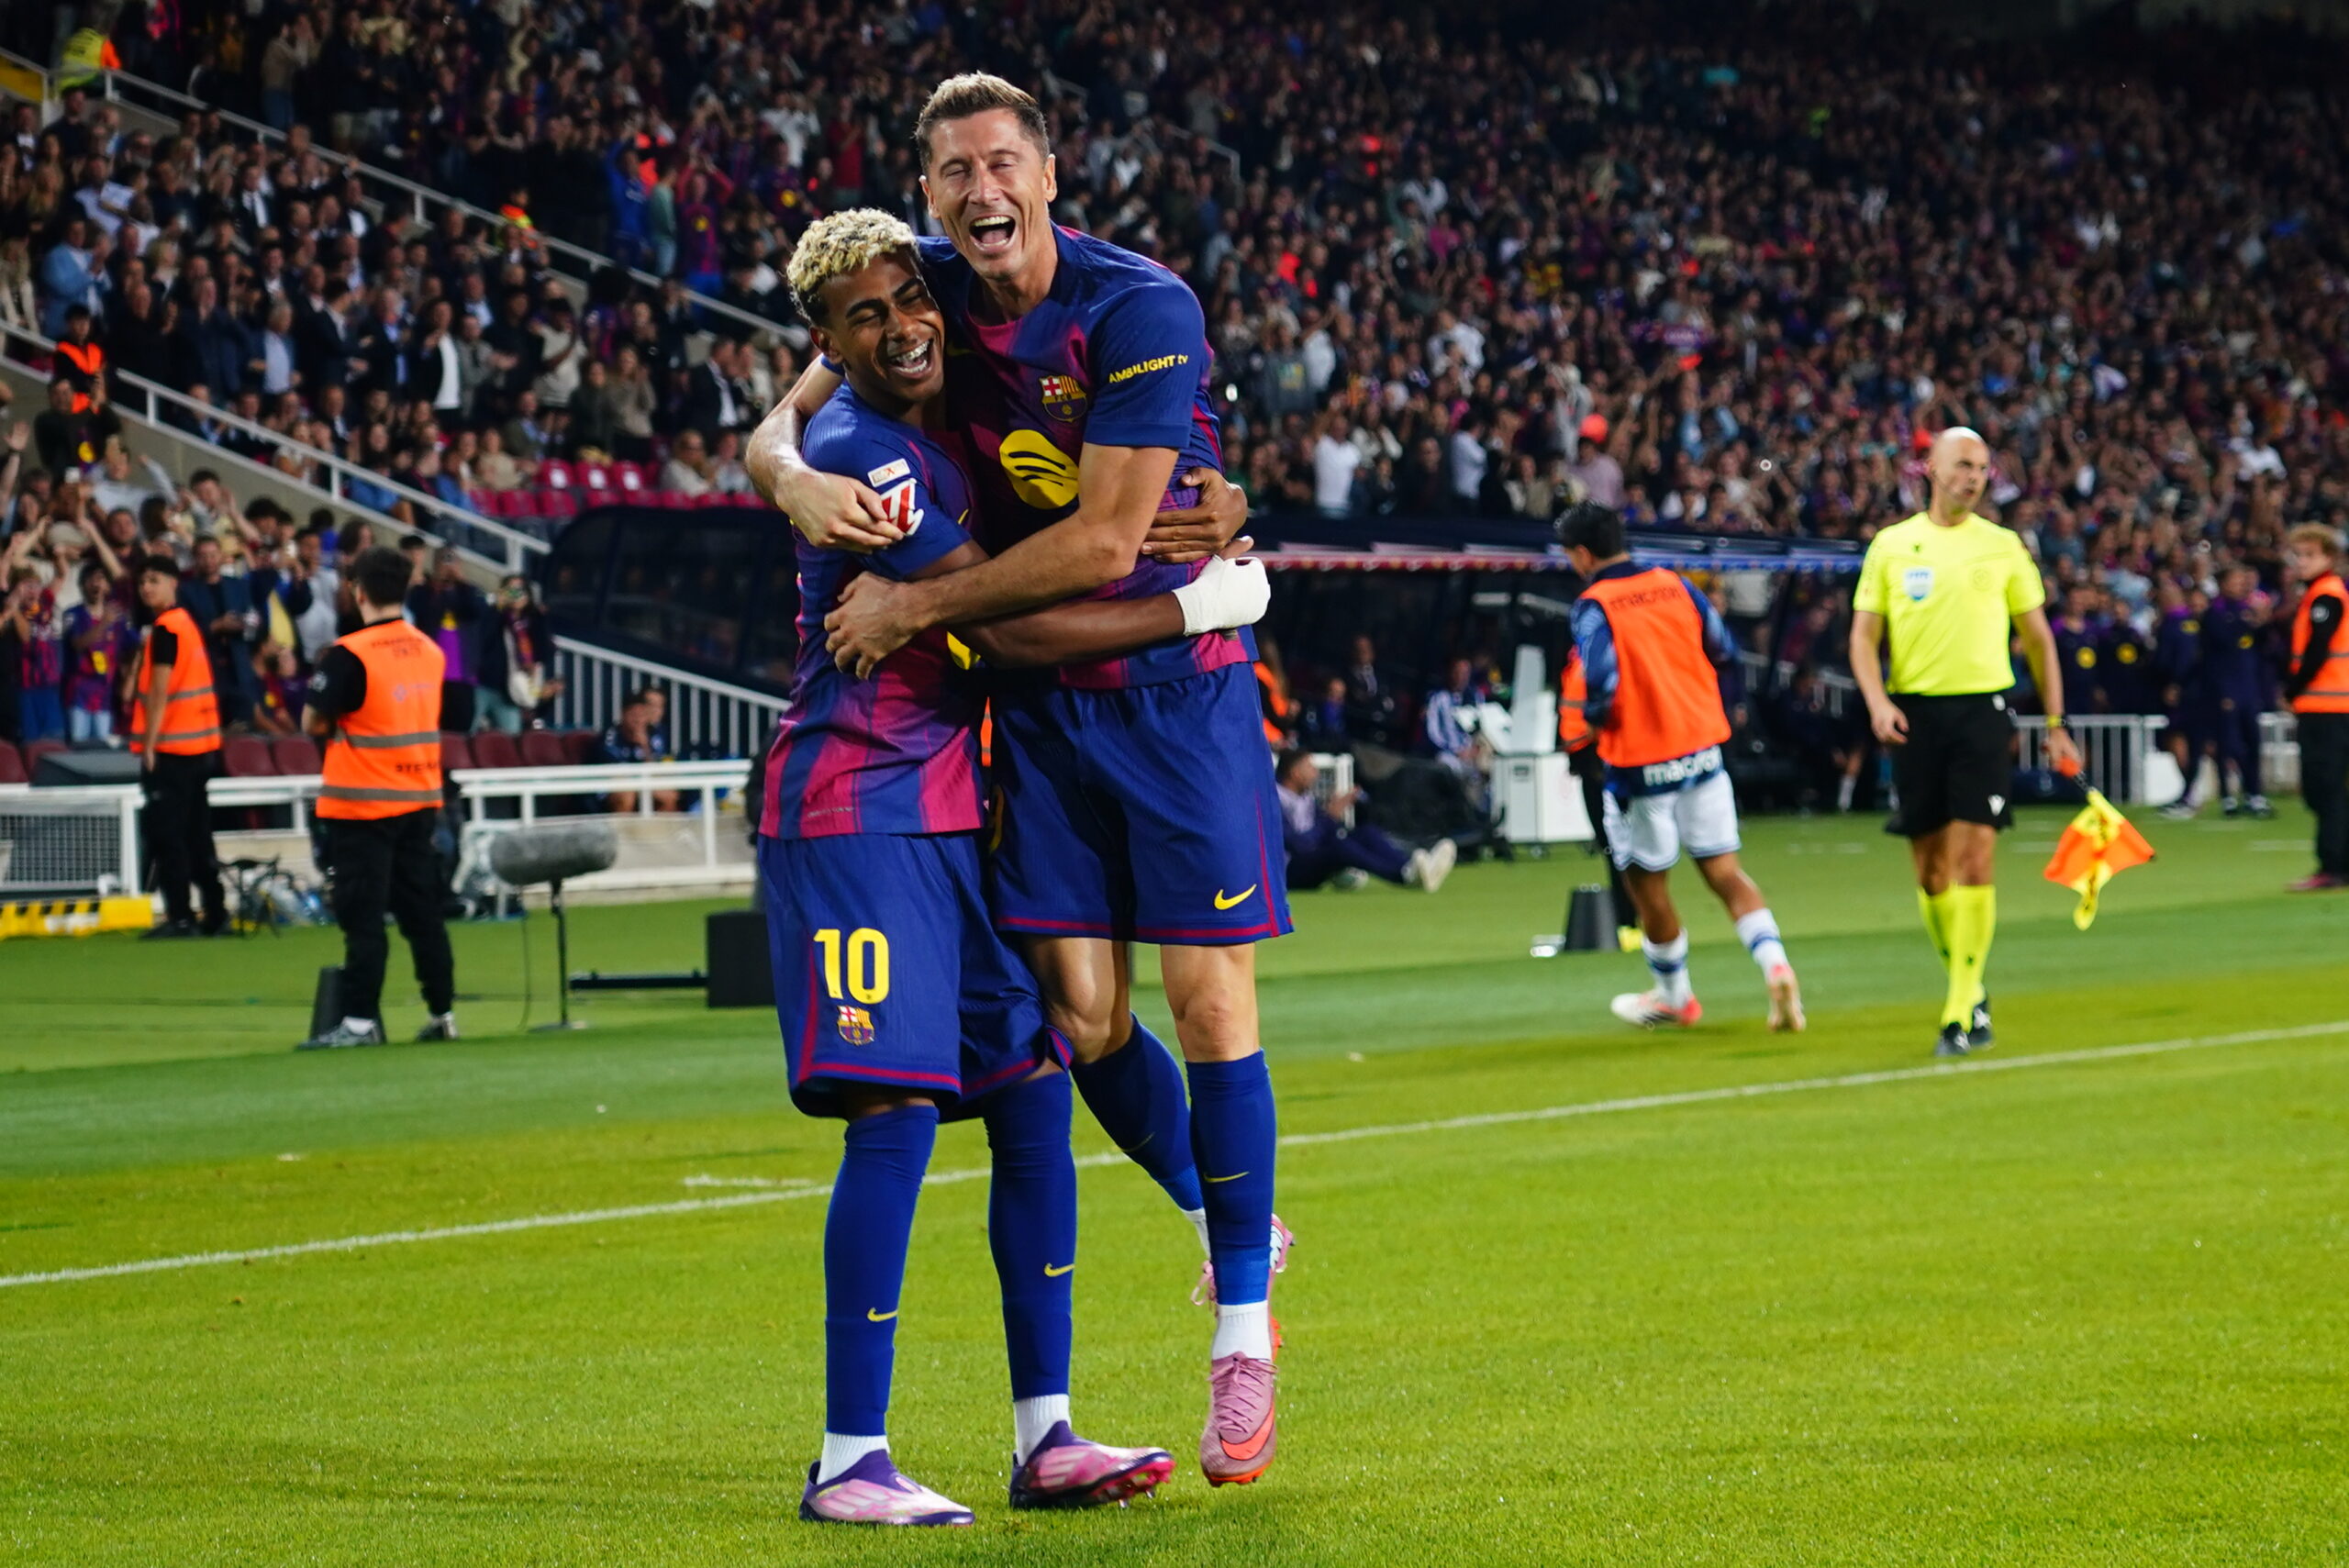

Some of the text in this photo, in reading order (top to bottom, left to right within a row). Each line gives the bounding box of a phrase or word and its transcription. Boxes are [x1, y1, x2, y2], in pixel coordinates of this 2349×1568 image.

[1108, 354, 1188, 384] AMBILIGHT tv
[813, 928, 890, 1005] 10
